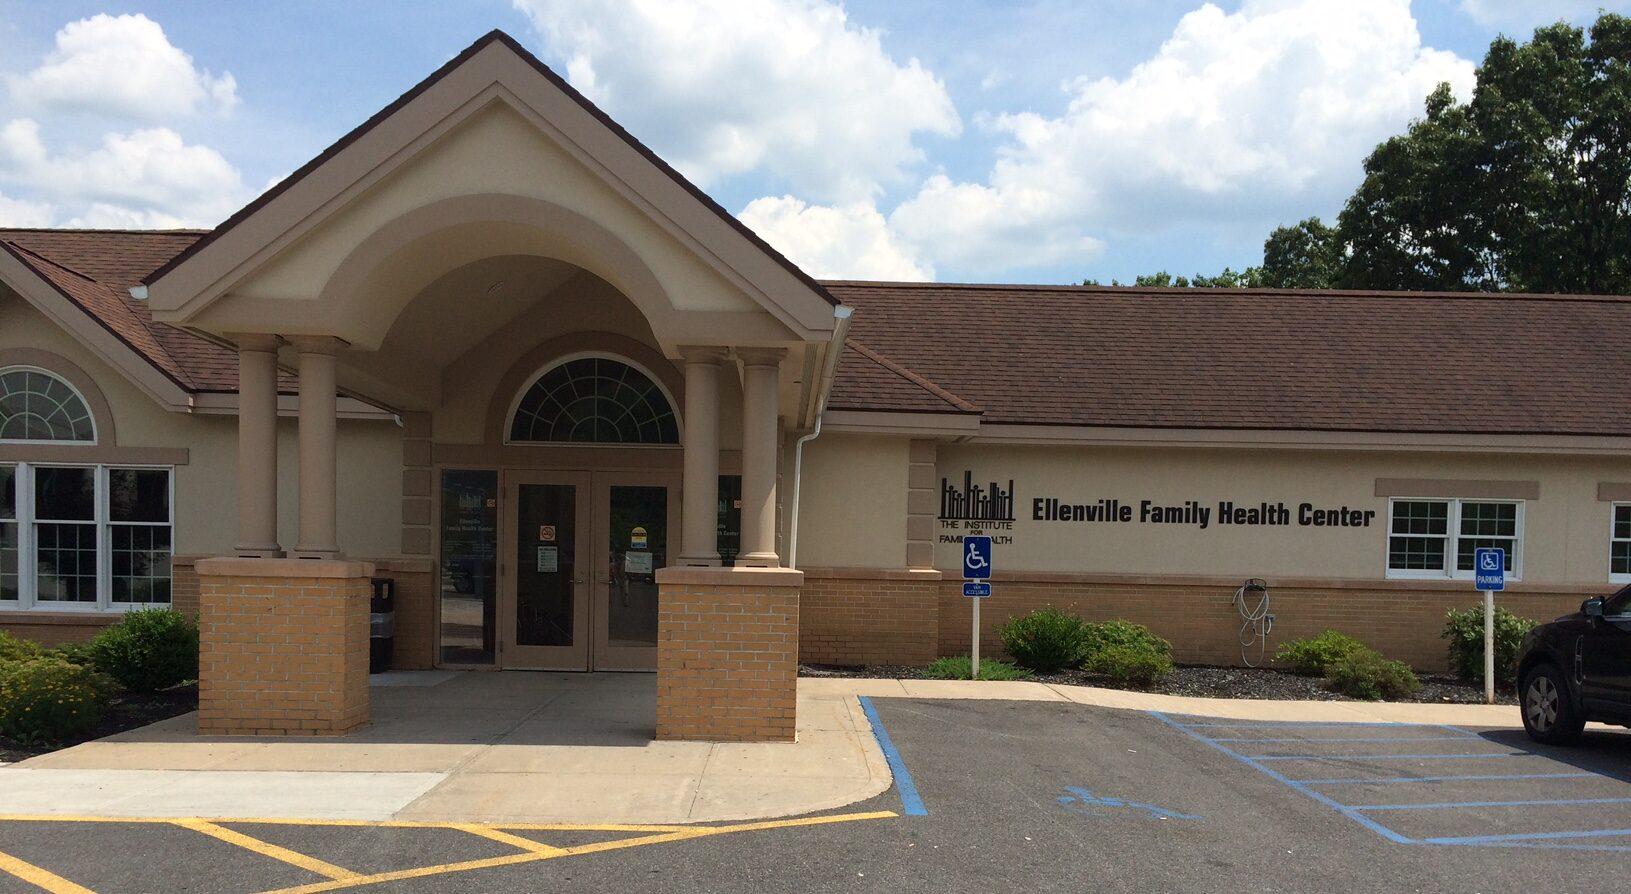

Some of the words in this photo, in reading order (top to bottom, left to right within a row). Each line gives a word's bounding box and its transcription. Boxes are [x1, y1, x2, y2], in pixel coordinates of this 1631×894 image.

[1032, 498, 1132, 522] Ellenville
[1140, 500, 1210, 529] Family
[1218, 501, 1290, 526] Health
[1298, 502, 1376, 527] Center
[940, 520, 959, 529] THE
[964, 521, 1013, 530] INSTITUTE
[991, 536, 1013, 544] ALTH
[1477, 575, 1503, 584] PARKING
